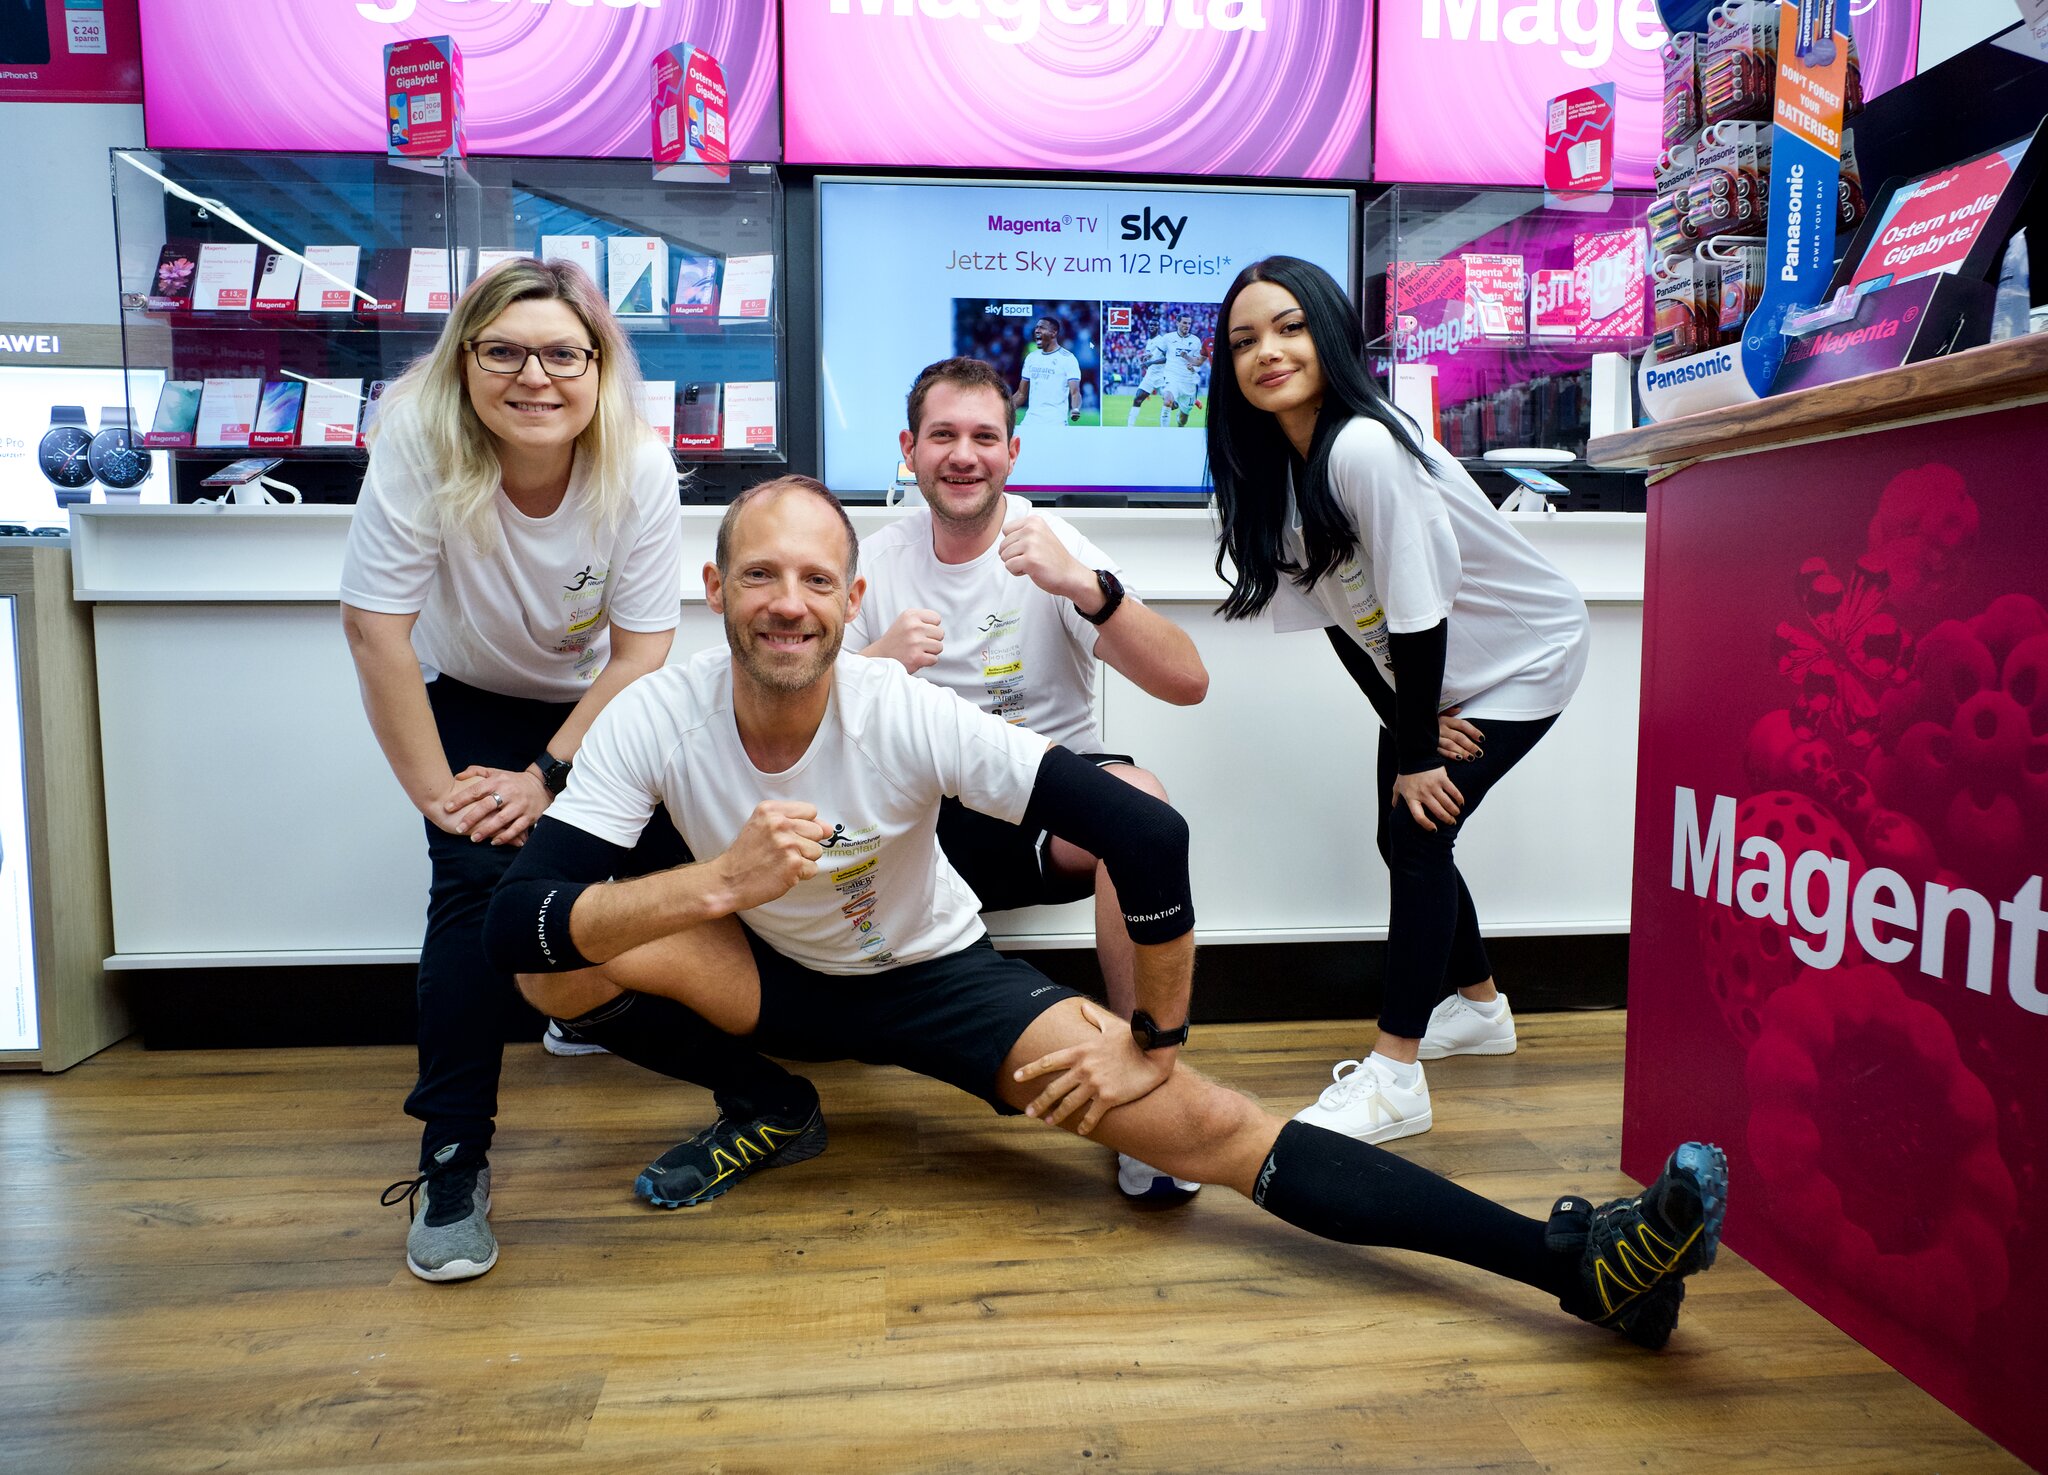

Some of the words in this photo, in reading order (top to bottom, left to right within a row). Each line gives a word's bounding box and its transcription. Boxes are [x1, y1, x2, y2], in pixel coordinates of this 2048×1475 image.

[82, 26, 99, 35] 240
[1708, 22, 1750, 51] Panasonic
[390, 63, 418, 77] Ostern
[419, 60, 445, 72] voller
[689, 67, 713, 87] Ostern
[396, 73, 438, 89] Gigabyte!
[1781, 63, 1808, 89] DON'T
[1808, 80, 1841, 109] FORGET
[695, 83, 724, 108] Gigabyte!
[1800, 93, 1820, 115] YOUR
[1777, 98, 1839, 149] BATTERIES!
[1699, 145, 1736, 168] Panasonic
[1658, 166, 1695, 192] Panasonic
[1816, 179, 1824, 199] DAY
[988, 215, 1062, 236] Magenta
[1076, 216, 1098, 233] TV
[1120, 206, 1189, 250] sky
[1781, 164, 1805, 282] Panasonic
[1814, 204, 1822, 230] YOUR
[1881, 214, 1946, 247] Ostern
[1812, 234, 1821, 269] POWER
[1883, 218, 1980, 266] Gigabyte!
[946, 250, 1008, 271] Jetzt
[1015, 250, 1056, 277] Sky
[1063, 255, 1111, 273] zum
[1119, 253, 1151, 274] 1/2
[1656, 278, 1692, 298] Panasonic
[149, 300, 180, 308] Magenta
[256, 301, 286, 310] Magenta
[363, 302, 392, 311] Magenta
[675, 306, 704, 314] Magenta
[984, 304, 1002, 315] sky
[1004, 305, 1031, 316] sport
[1809, 318, 1900, 357] Magenta
[1646, 352, 1732, 392] Panasonic
[150, 435, 181, 443] Magenta
[254, 435, 284, 443] Magenta
[682, 437, 711, 445] Magenta
[1671, 785, 2048, 1016] Magent
[537, 889, 558, 956] GORNATION
[1127, 904, 1182, 923] GORNATION
